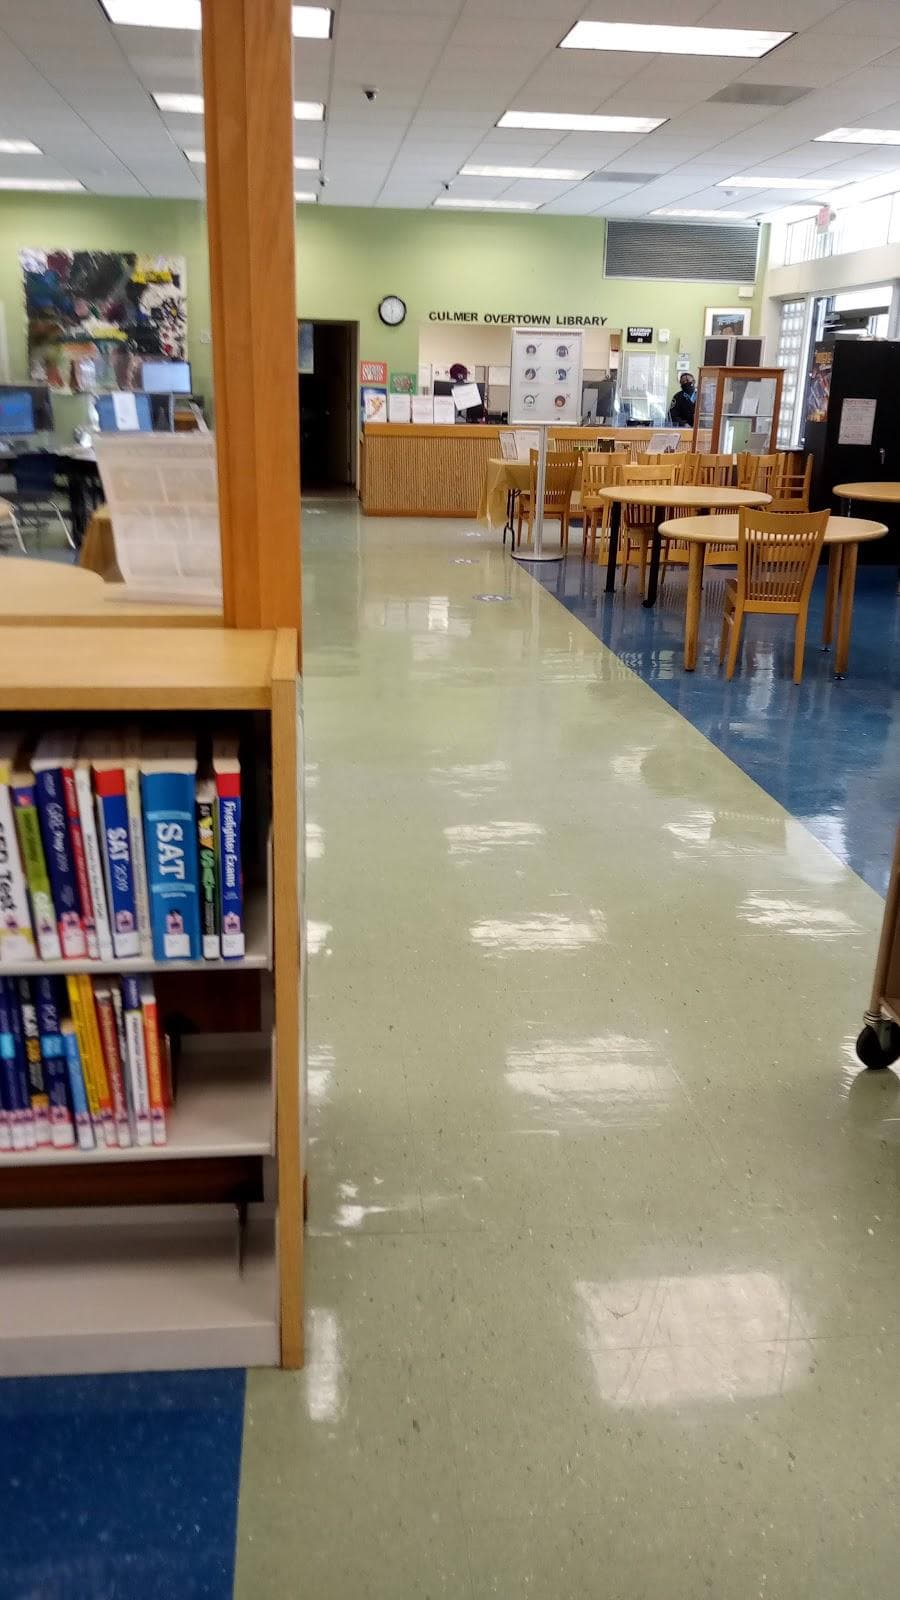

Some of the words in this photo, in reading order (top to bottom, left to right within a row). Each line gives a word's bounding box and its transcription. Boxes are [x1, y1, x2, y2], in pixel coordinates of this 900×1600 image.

[428, 311, 479, 322] CULMER
[484, 314, 551, 325] OVERTOWN
[556, 315, 608, 326] LIBRARY
[222, 800, 237, 853] Firefighter
[107, 827, 129, 861] SAT
[156, 822, 186, 879] SAT
[225, 854, 237, 887] Exams
